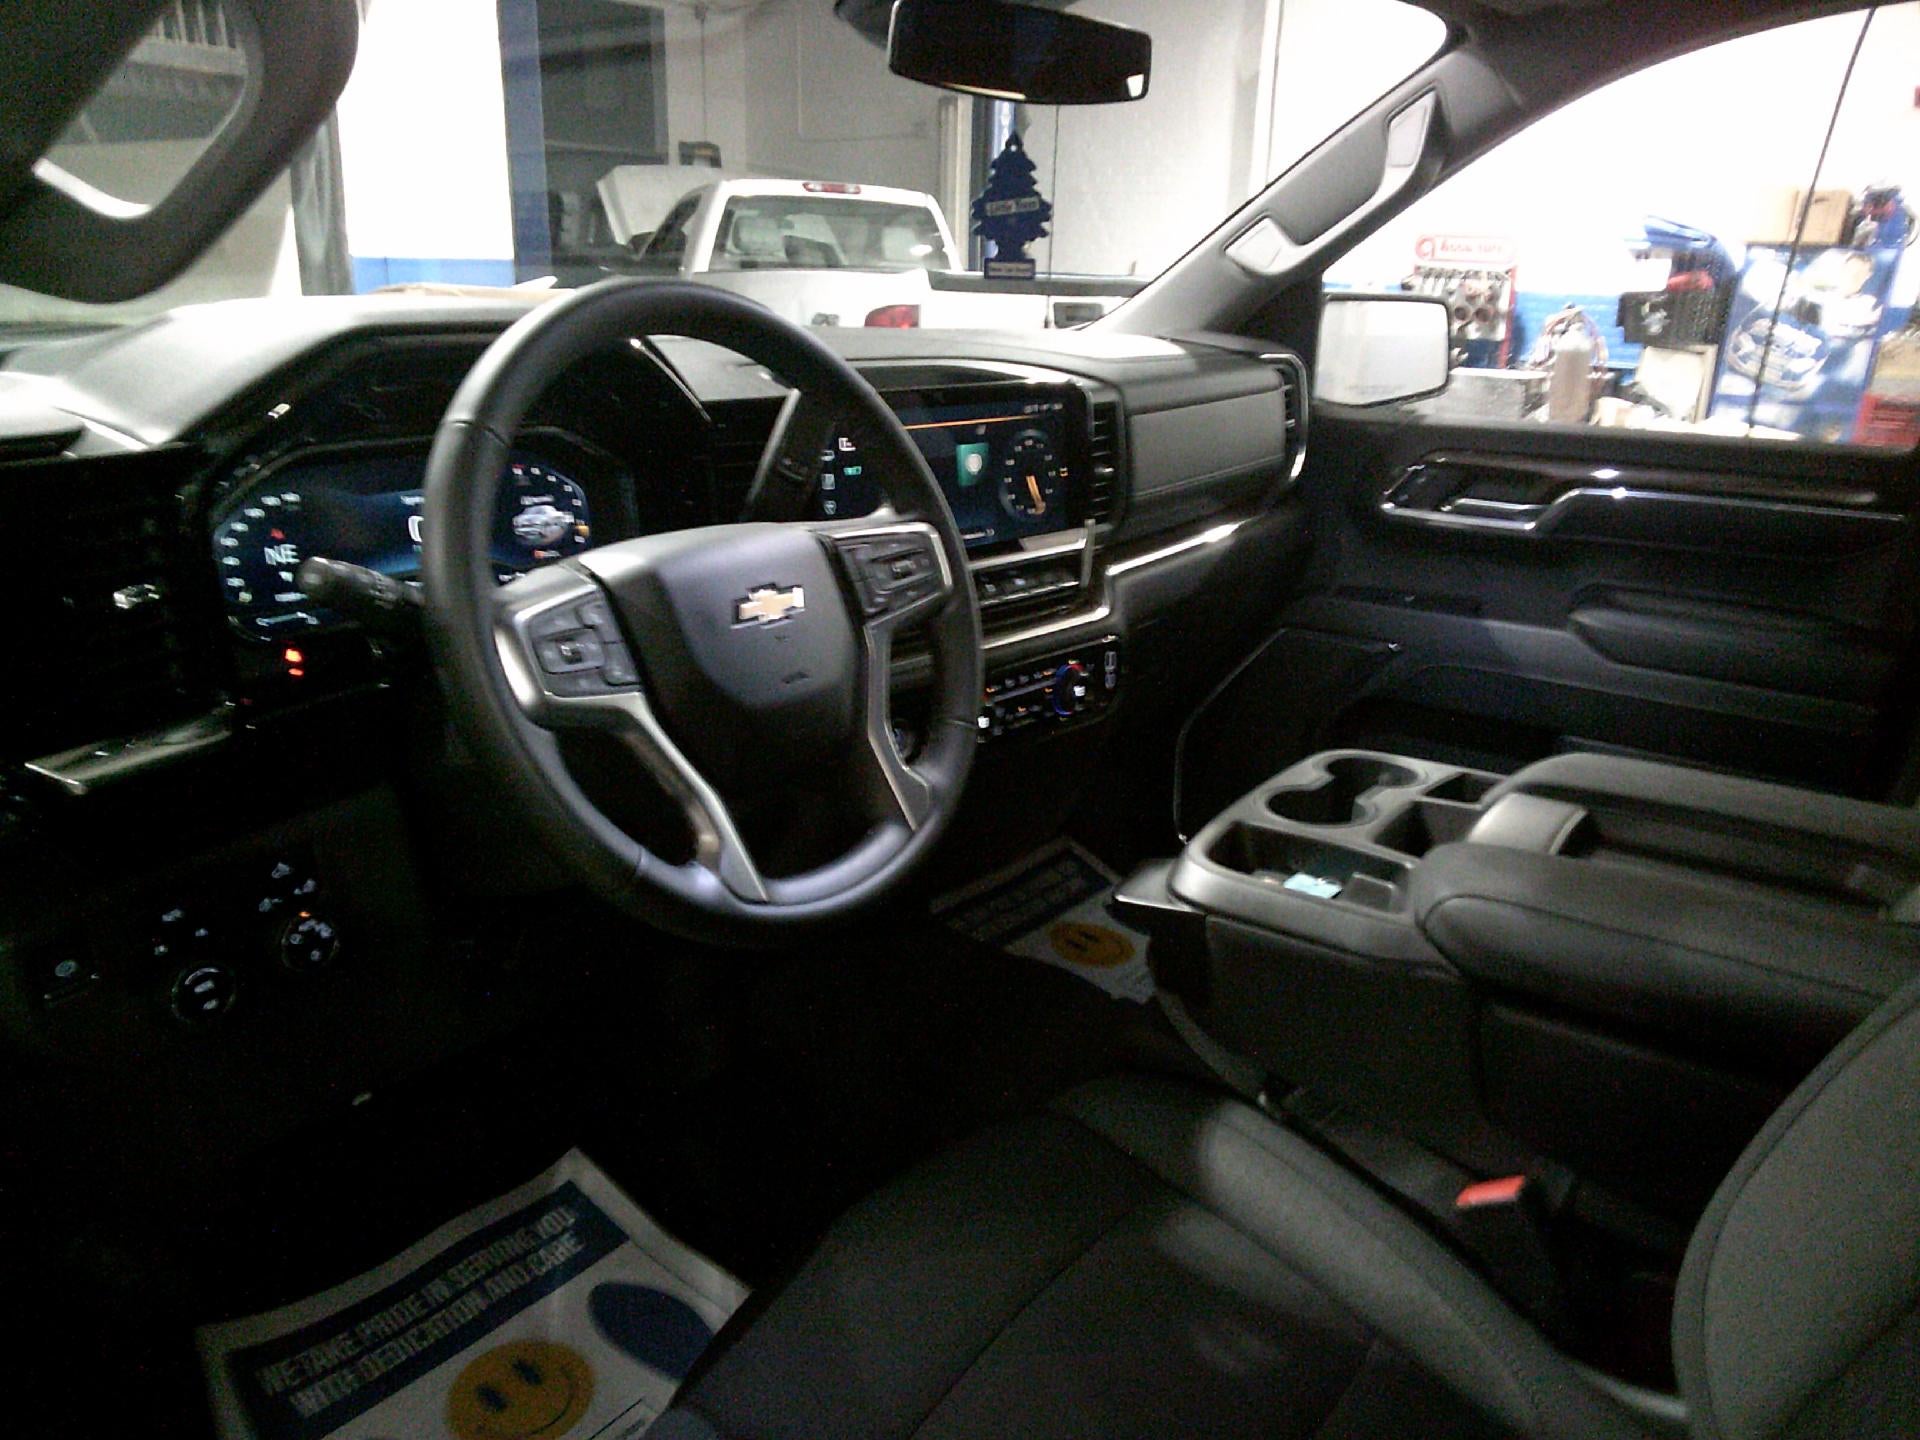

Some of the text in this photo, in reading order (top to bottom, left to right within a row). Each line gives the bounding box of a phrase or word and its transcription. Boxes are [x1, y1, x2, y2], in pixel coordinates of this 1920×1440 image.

[264, 543, 300, 566] NE
[255, 1205, 577, 1396] WE TAKE PRIDE IN SERVING YOU
[289, 1230, 585, 1419] WITH DEDICATION AND CARE
